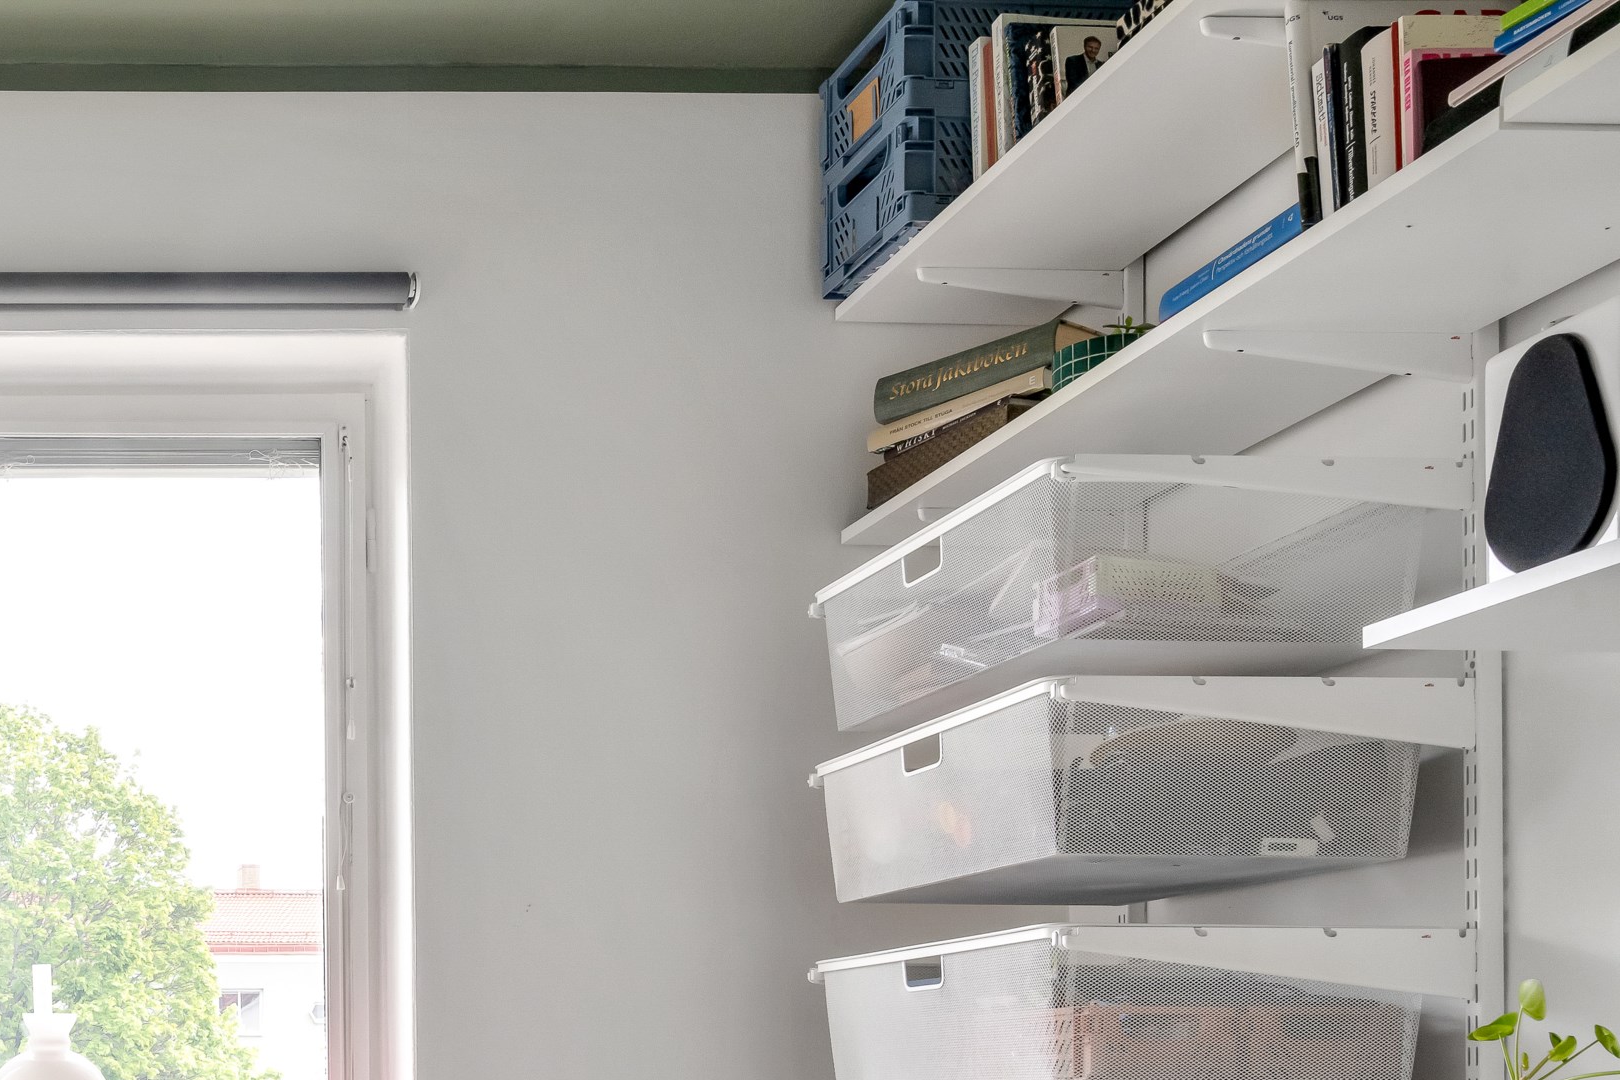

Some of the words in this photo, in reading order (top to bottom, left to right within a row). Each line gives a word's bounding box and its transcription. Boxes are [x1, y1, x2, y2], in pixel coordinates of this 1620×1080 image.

[972, 43, 980, 68] The
[972, 69, 981, 116] Phoenix
[1369, 89, 1378, 135] STARKARE
[889, 373, 934, 400] Stora
[932, 342, 1028, 392] Jaktboken
[889, 425, 904, 435] FRÅN
[905, 419, 922, 431] STOCK
[923, 415, 934, 424] TILL
[934, 408, 953, 419] STUGA
